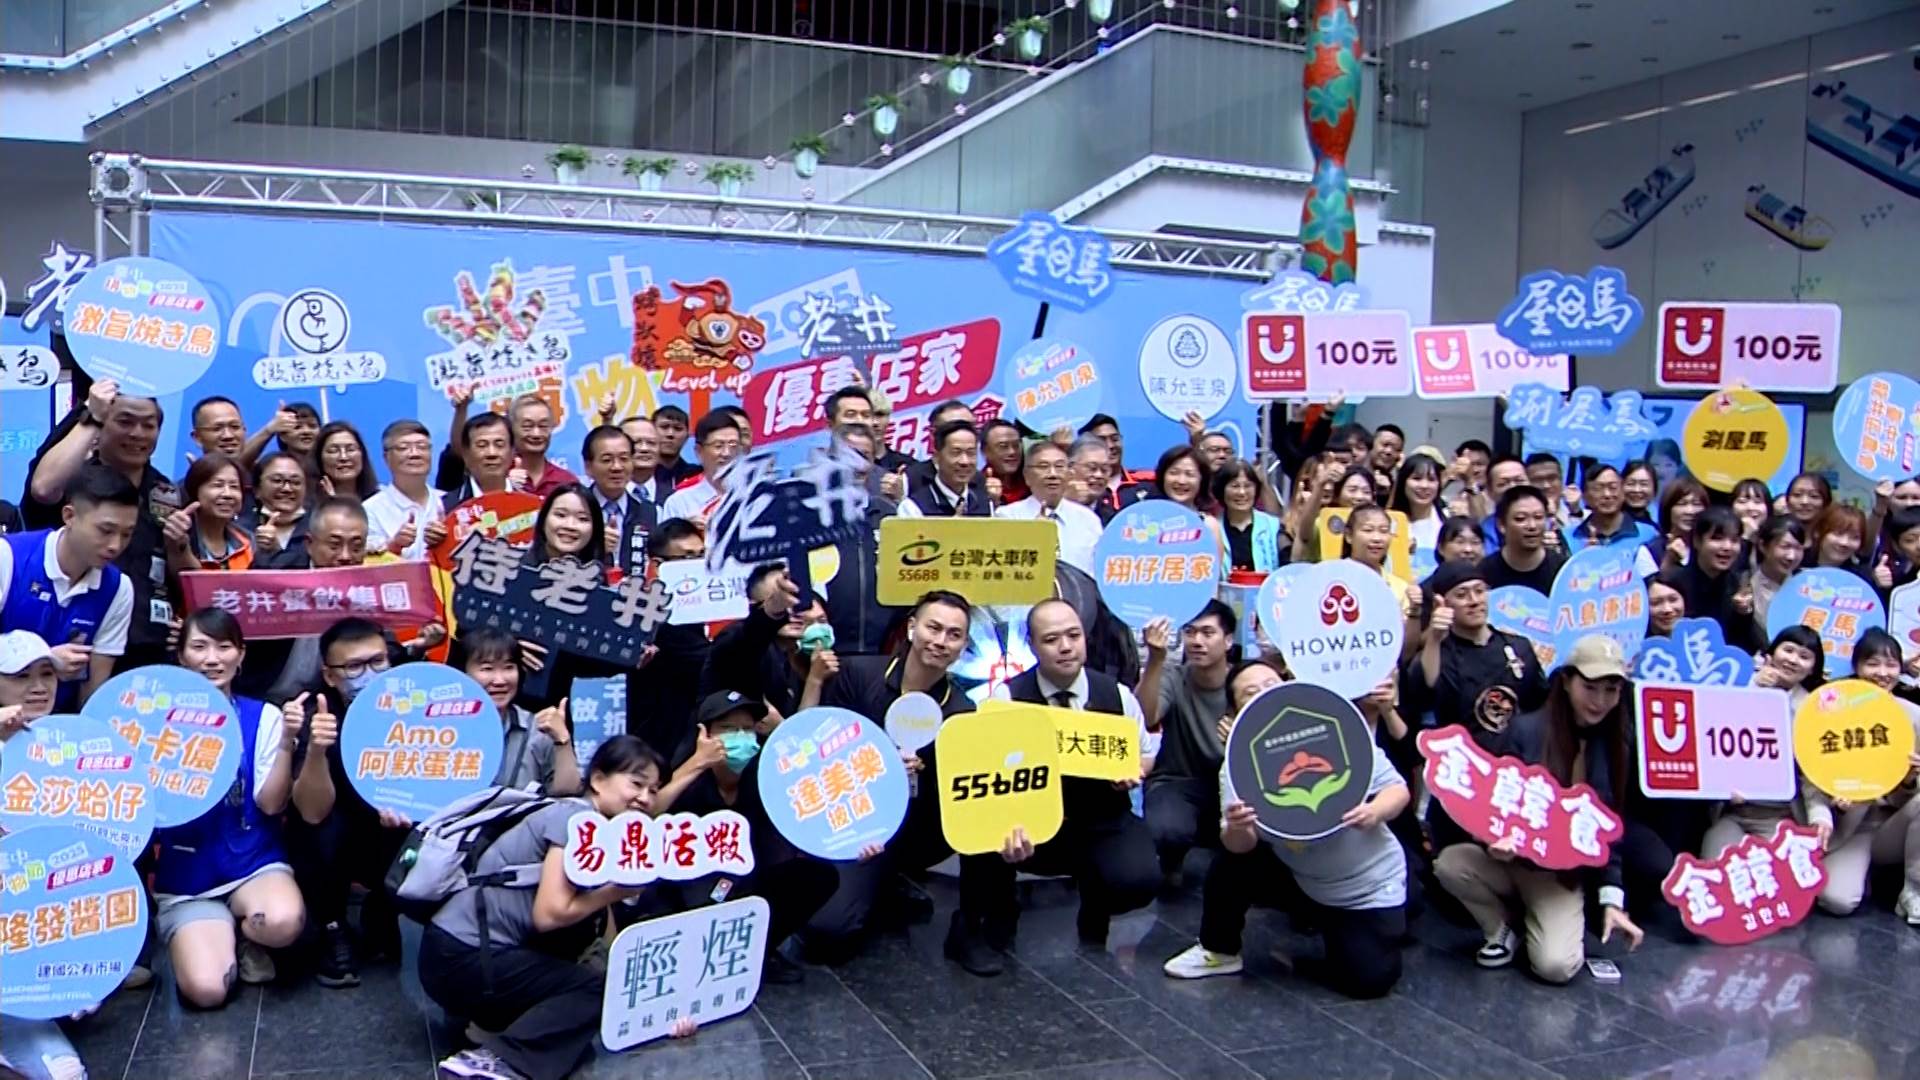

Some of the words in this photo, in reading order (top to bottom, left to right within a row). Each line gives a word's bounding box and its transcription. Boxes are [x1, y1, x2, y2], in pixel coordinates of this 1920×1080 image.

[1503, 277, 1633, 336] 屋馬
[1315, 340, 1397, 365] 100元
[1734, 335, 1822, 361] 100元
[661, 367, 718, 392] Level
[724, 371, 752, 397] up
[1702, 430, 1767, 452] 涮屋馬
[950, 549, 1039, 567] 台灣大車隊
[1105, 554, 1213, 584] 翔仔居家
[898, 569, 939, 582] 55688
[1291, 630, 1394, 657] HOWARD
[387, 721, 457, 747] Amo
[1706, 728, 1779, 760] 100元
[1820, 724, 1890, 756] 金韓食
[357, 750, 482, 780] 阿默蛋糕
[788, 742, 886, 820] 達美樂
[952, 765, 1049, 801] 55688
[1427, 734, 1616, 857] 金韓食
[3, 772, 146, 822] 金莎蛤仔
[572, 820, 746, 873] 易鼎活蝦
[1671, 829, 1823, 926] 金韓食
[620, 911, 757, 1010] 輕煙
